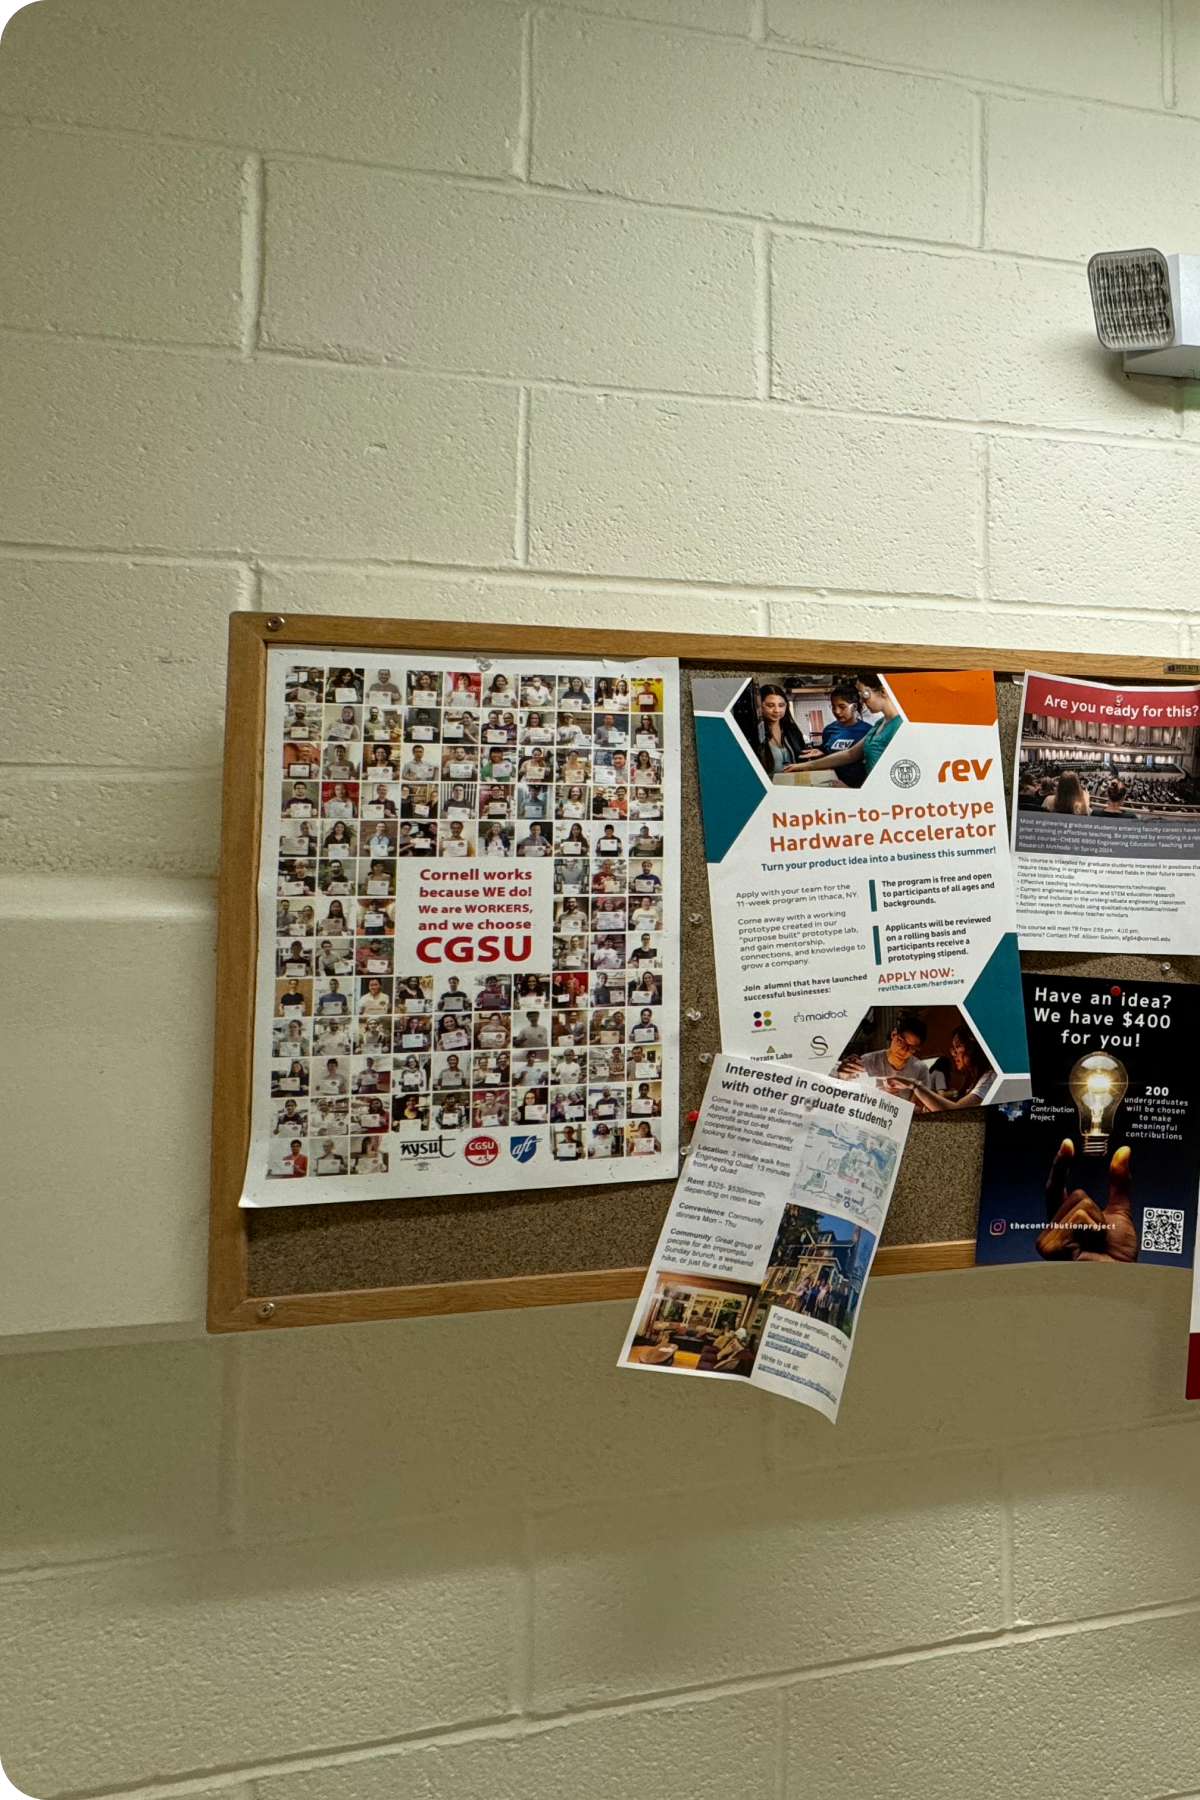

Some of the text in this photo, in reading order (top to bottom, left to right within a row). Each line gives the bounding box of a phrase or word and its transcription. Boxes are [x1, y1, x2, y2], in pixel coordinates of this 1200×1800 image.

[1044, 694, 1199, 720] Are you ready for this?
[938, 758, 993, 783] rev
[772, 801, 994, 830] Napkin-to-Prototype
[770, 823, 996, 852] Hardware Accelerator
[761, 863, 784, 872] Turn
[785, 862, 807, 872] your
[809, 858, 847, 870] product
[848, 856, 868, 865] idea
[869, 855, 889, 863] into
[897, 851, 936, 861] business
[937, 849, 955, 858] this
[956, 846, 996, 857] summer!
[420, 868, 532, 881] Cornell works
[419, 886, 532, 898] because WE do!
[418, 905, 438, 914] We
[464, 904, 533, 914] WORKERS,
[418, 918, 532, 931] and we choose
[416, 935, 532, 964] CGSU
[878, 967, 954, 984] APPLY NOW:
[878, 979, 965, 992] revithaca.com/hardware
[1035, 987, 1172, 1009] Have an idea?
[1034, 1007, 1171, 1029] We have $400
[1061, 1029, 1140, 1049] for you!
[725, 1062, 899, 1118] Interested in cooperative living
[1145, 1086, 1169, 1096] 200
[721, 1080, 893, 1130] with other graduate students?
[1124, 1096, 1189, 1106] undergraduates
[1030, 1105, 1075, 1113] Contribution
[1144, 1105, 1155, 1113] be
[1157, 1106, 1186, 1114] chosen
[1030, 1113, 1055, 1122] Project
[1131, 1123, 1178, 1132] meaningful
[1125, 1131, 1183, 1140] contributions
[469, 1141, 494, 1150] CGSU
[1010, 1221, 1116, 1231] thecontributionproject
